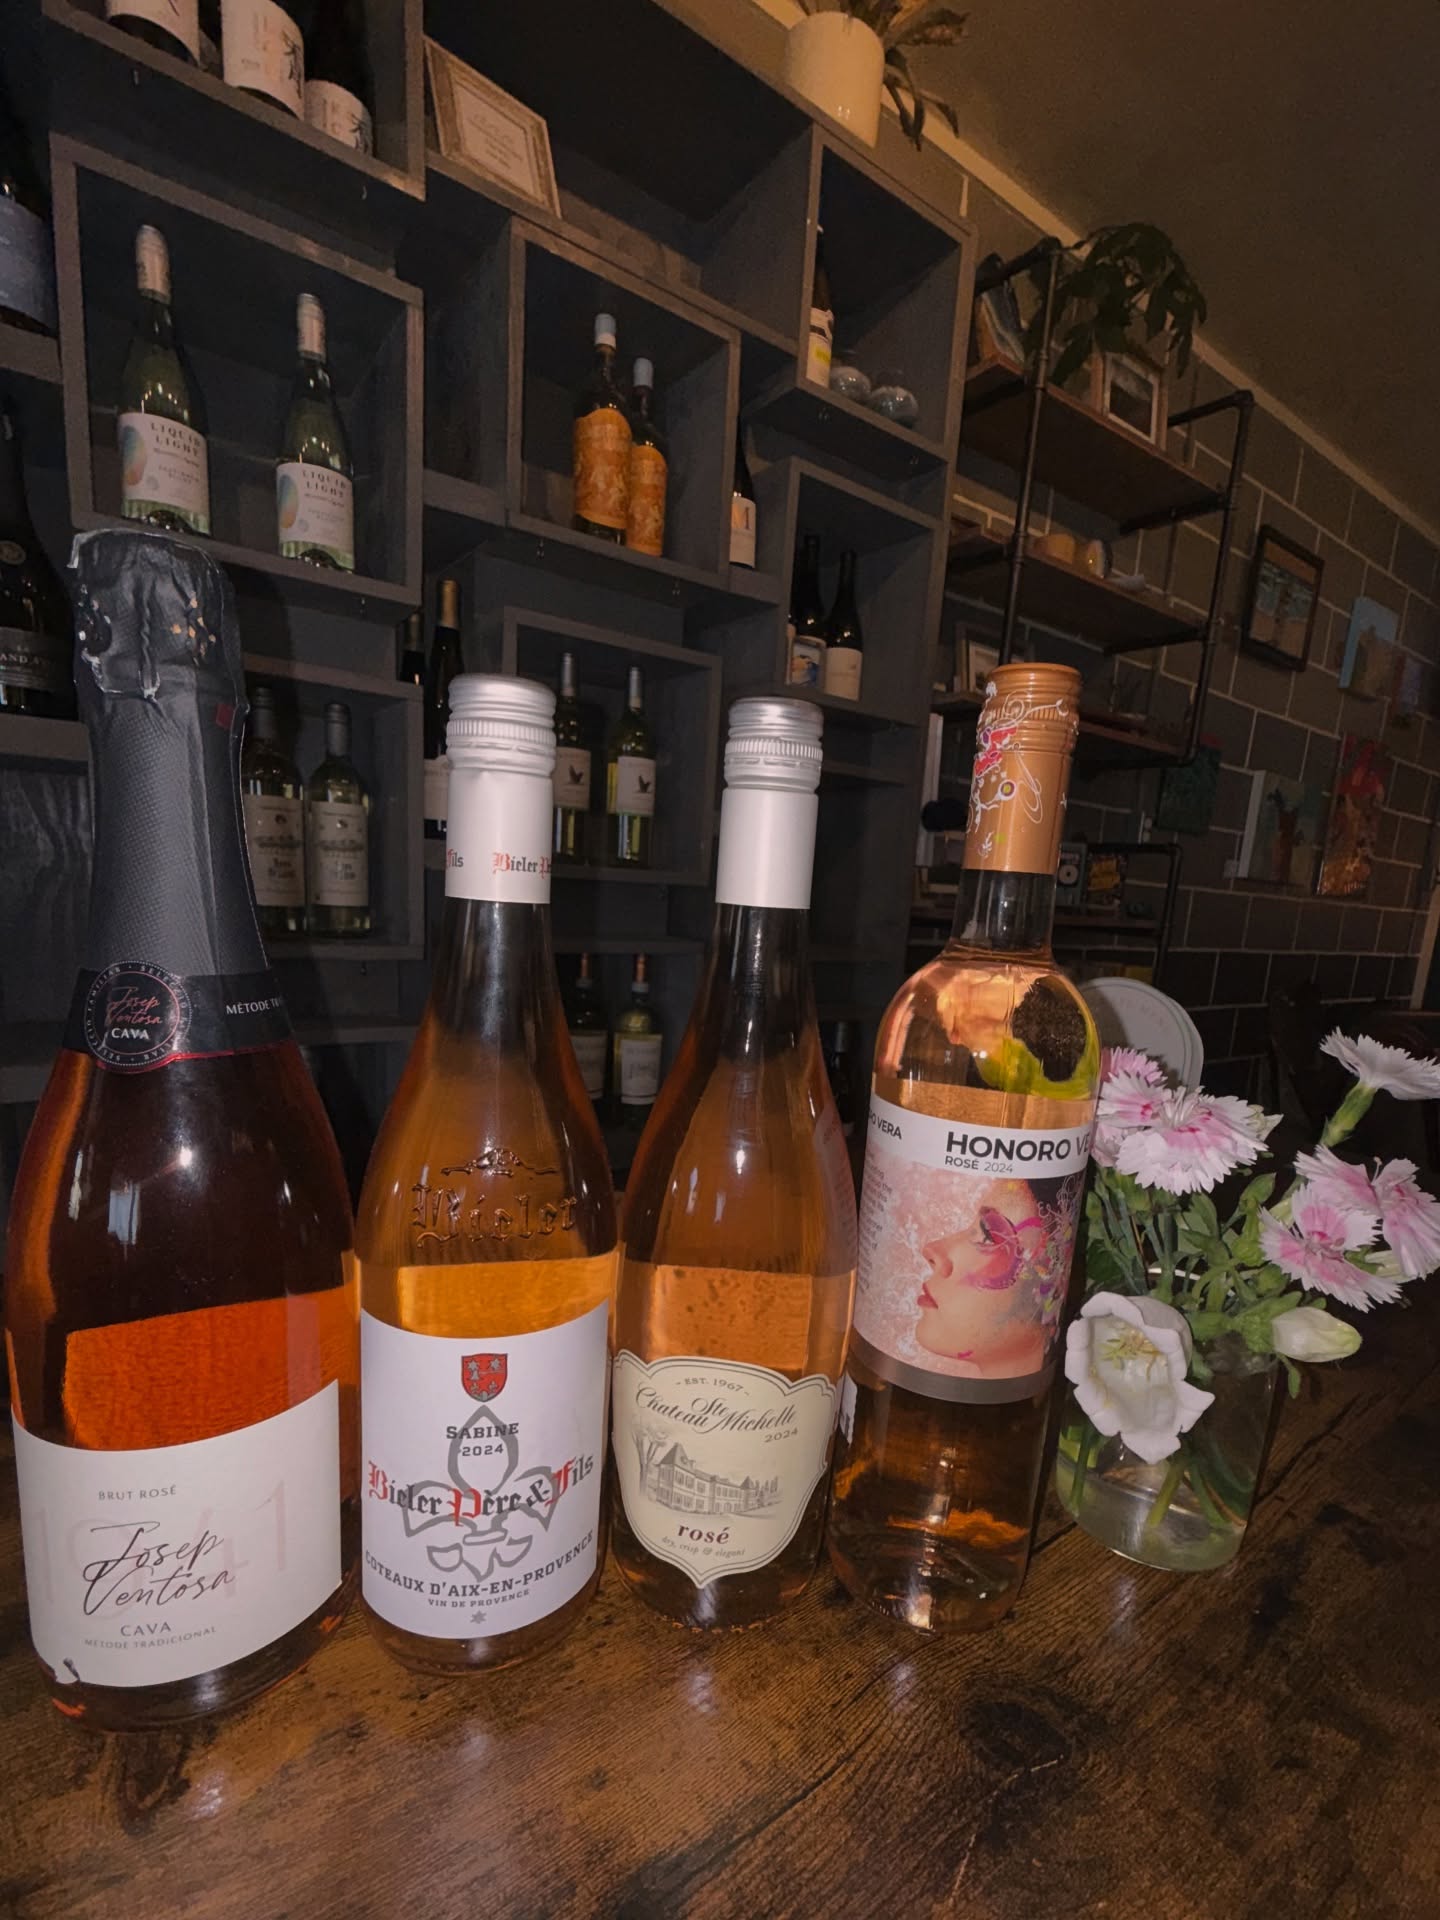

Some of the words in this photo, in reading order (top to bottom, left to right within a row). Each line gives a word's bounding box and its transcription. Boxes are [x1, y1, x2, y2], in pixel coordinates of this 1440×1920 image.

[111, 1027, 150, 1040] CAVA
[877, 1115, 903, 1141] VERA
[946, 1131, 1071, 1162] HONORO
[944, 1155, 980, 1171] ROSÉ
[984, 1161, 1014, 1174] 2024
[684, 1377, 709, 1386] EST.
[713, 1378, 744, 1392] 1967
[636, 1384, 709, 1427] Chateau
[694, 1404, 798, 1434] Michelle
[446, 1422, 519, 1440] SABINE
[764, 1427, 799, 1444] 2024
[462, 1443, 505, 1457] 2024
[98, 1490, 133, 1501] BRUT
[139, 1484, 177, 1498] ROSÉ
[368, 1460, 442, 1516] Bieler
[446, 1487, 522, 1527] Père
[526, 1478, 551, 1508] &
[545, 1454, 595, 1508] Fils
[678, 1525, 730, 1545] rosé
[83, 1520, 225, 1583] Josep
[365, 1550, 425, 1593] COTEAUX
[83, 1564, 236, 1617] Ventosa
[428, 1597, 448, 1608] VIN
[451, 1599, 467, 1608] DE
[470, 1587, 531, 1608] PROVENCE
[120, 1621, 172, 1637] CAVA
[134, 1625, 217, 1649] TRADICIONAL
